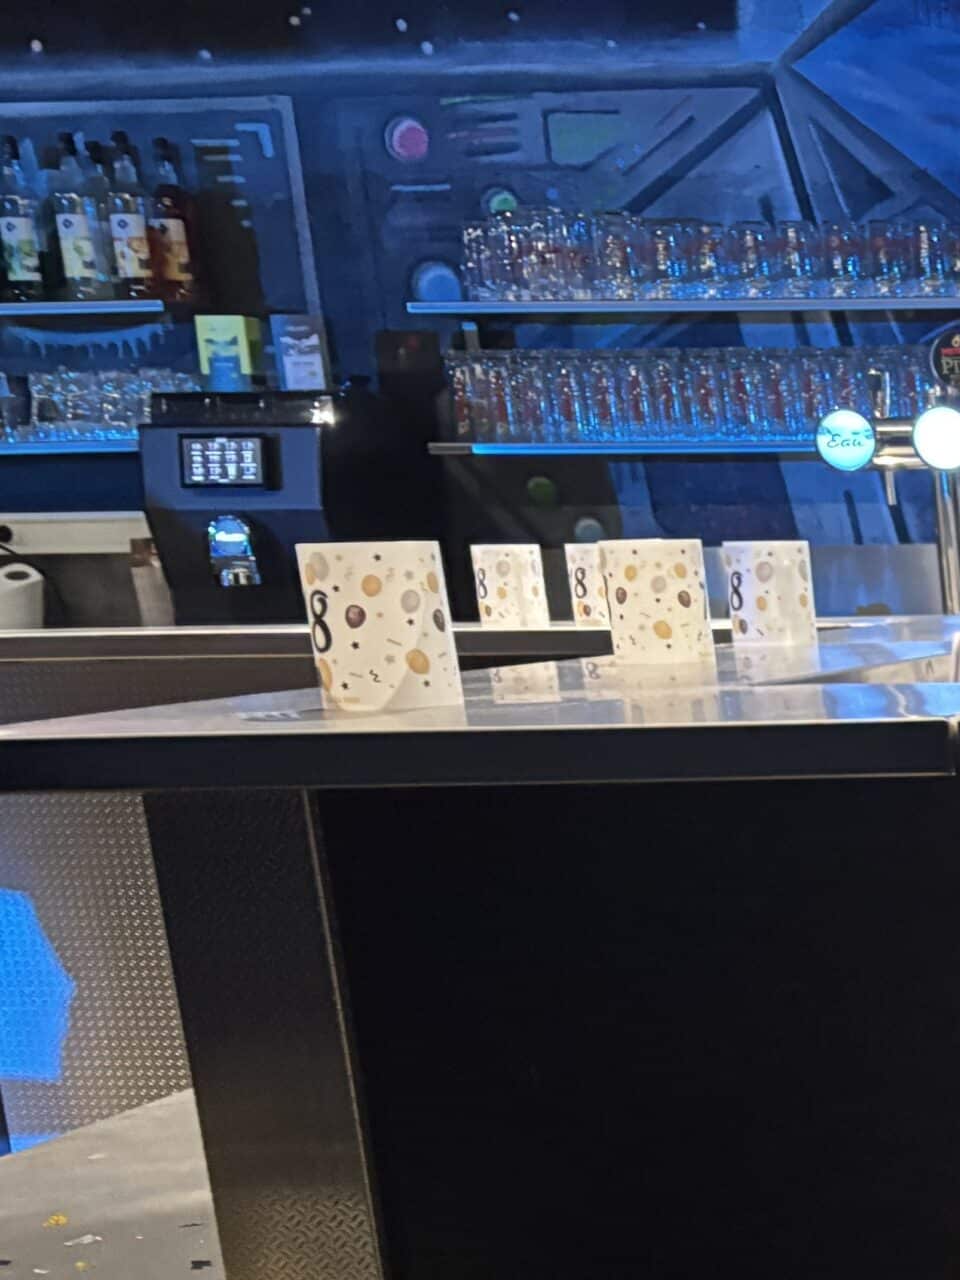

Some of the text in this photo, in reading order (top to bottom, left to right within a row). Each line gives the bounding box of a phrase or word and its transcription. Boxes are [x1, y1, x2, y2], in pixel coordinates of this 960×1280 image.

[827, 432, 864, 449] Eau
[730, 570, 744, 612] 8
[309, 589, 333, 653] 8
